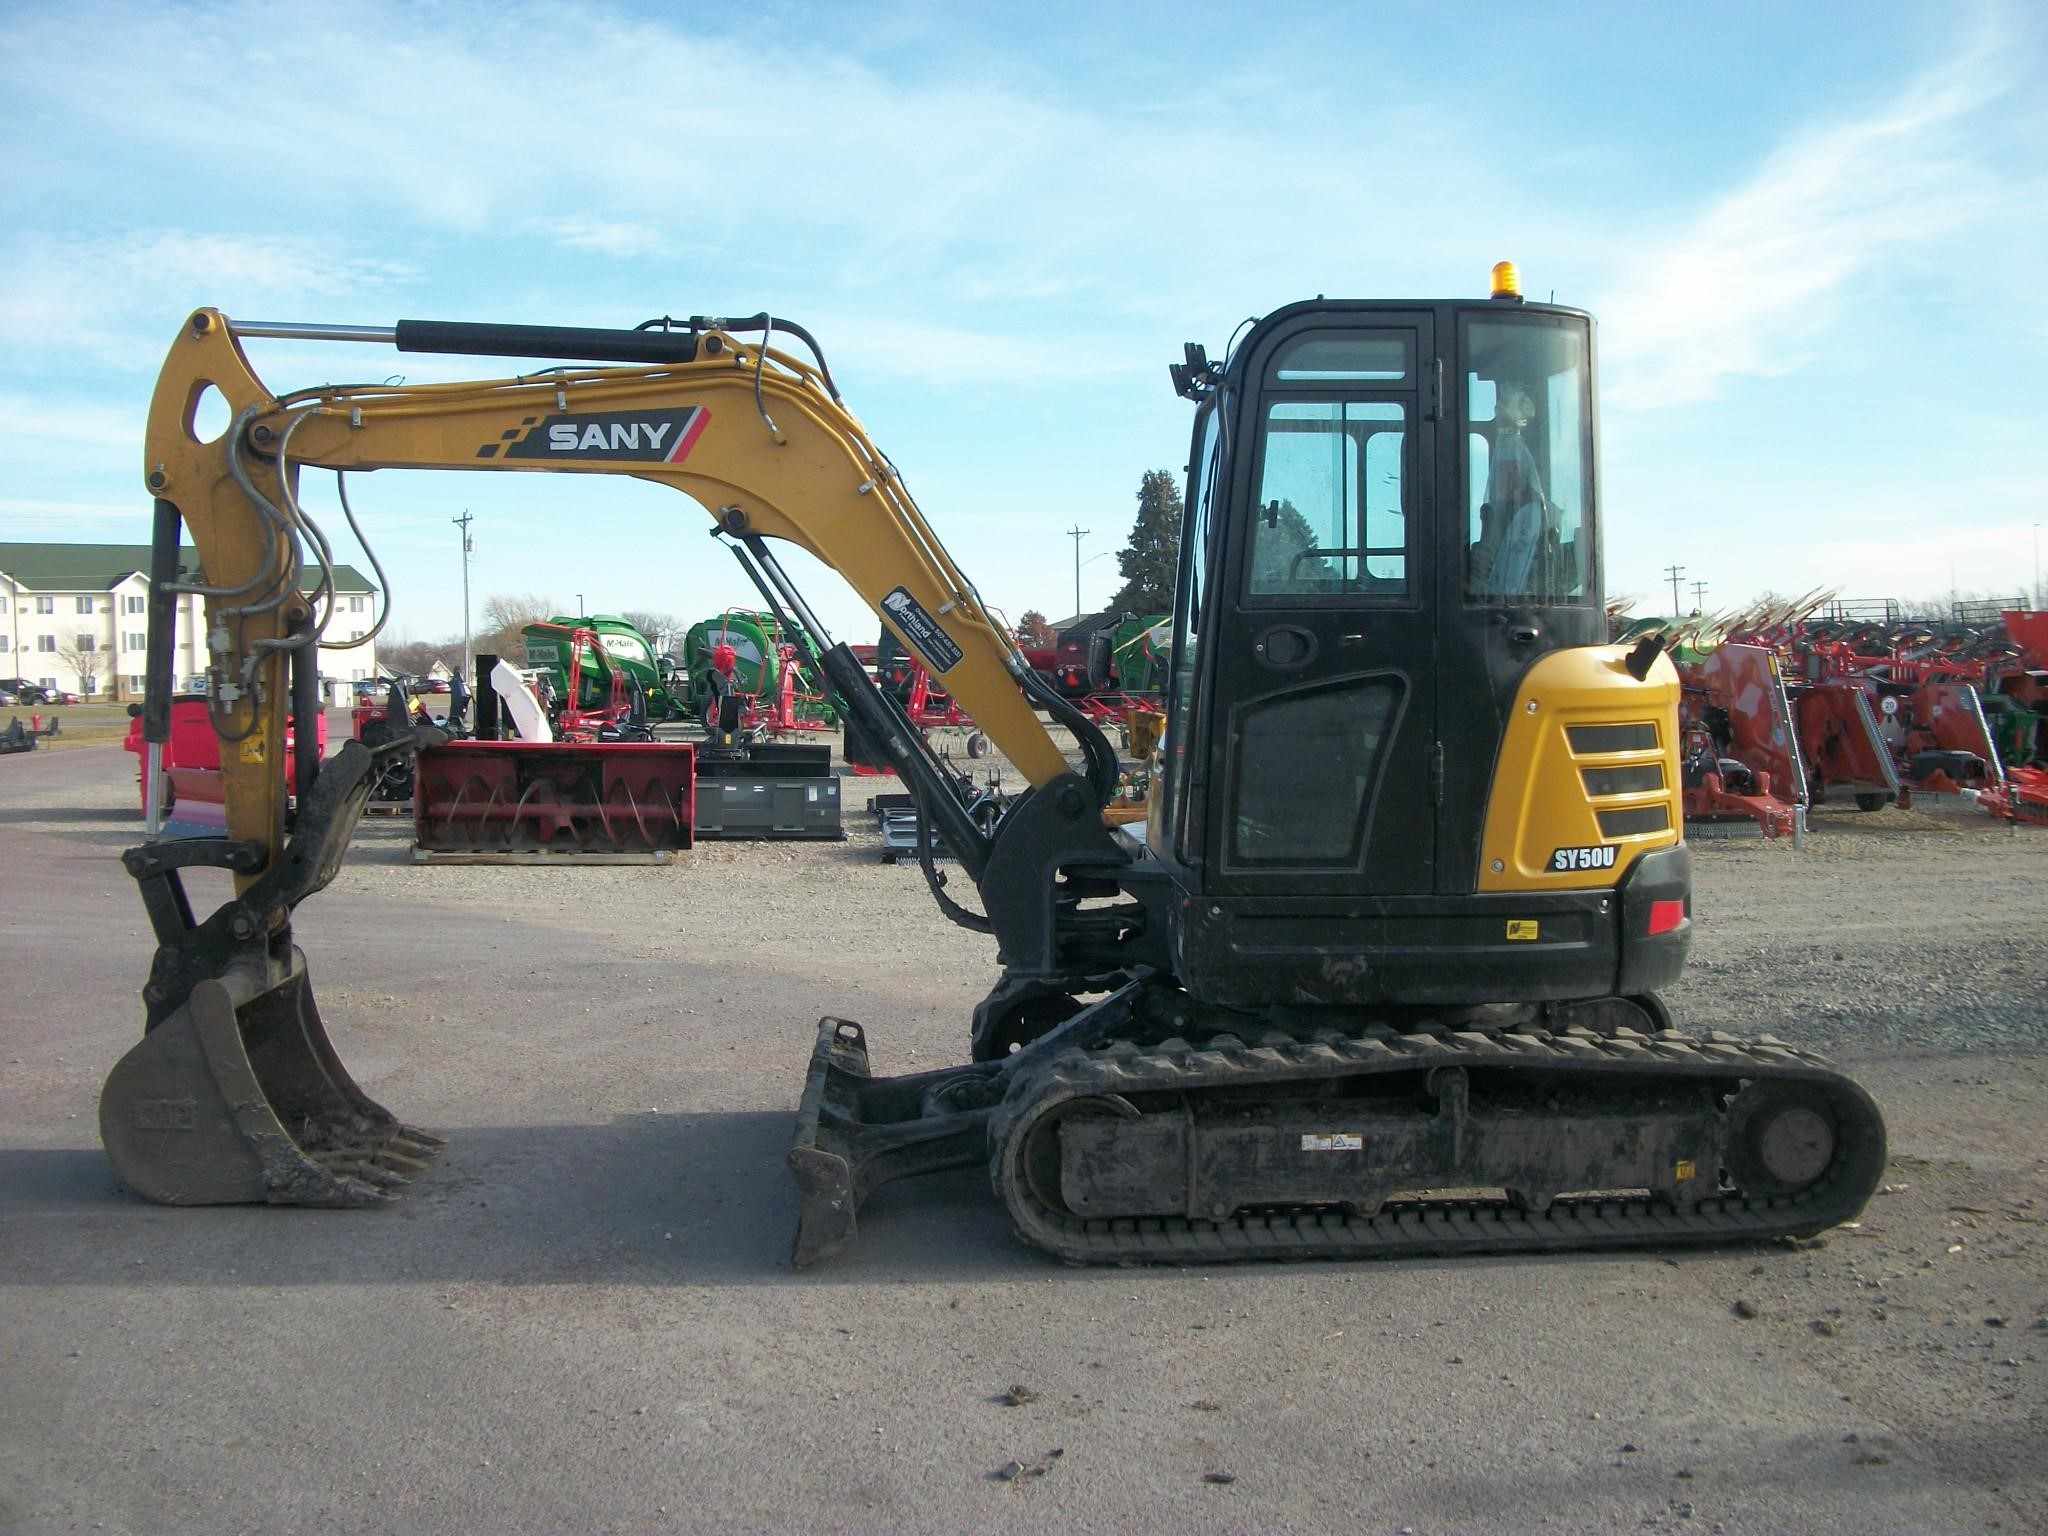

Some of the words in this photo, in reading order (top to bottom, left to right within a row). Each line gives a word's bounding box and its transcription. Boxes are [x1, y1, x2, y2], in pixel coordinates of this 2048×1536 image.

[549, 423, 671, 450] SANY
[884, 591, 931, 638] Northland
[1555, 847, 1614, 870] SY50U
